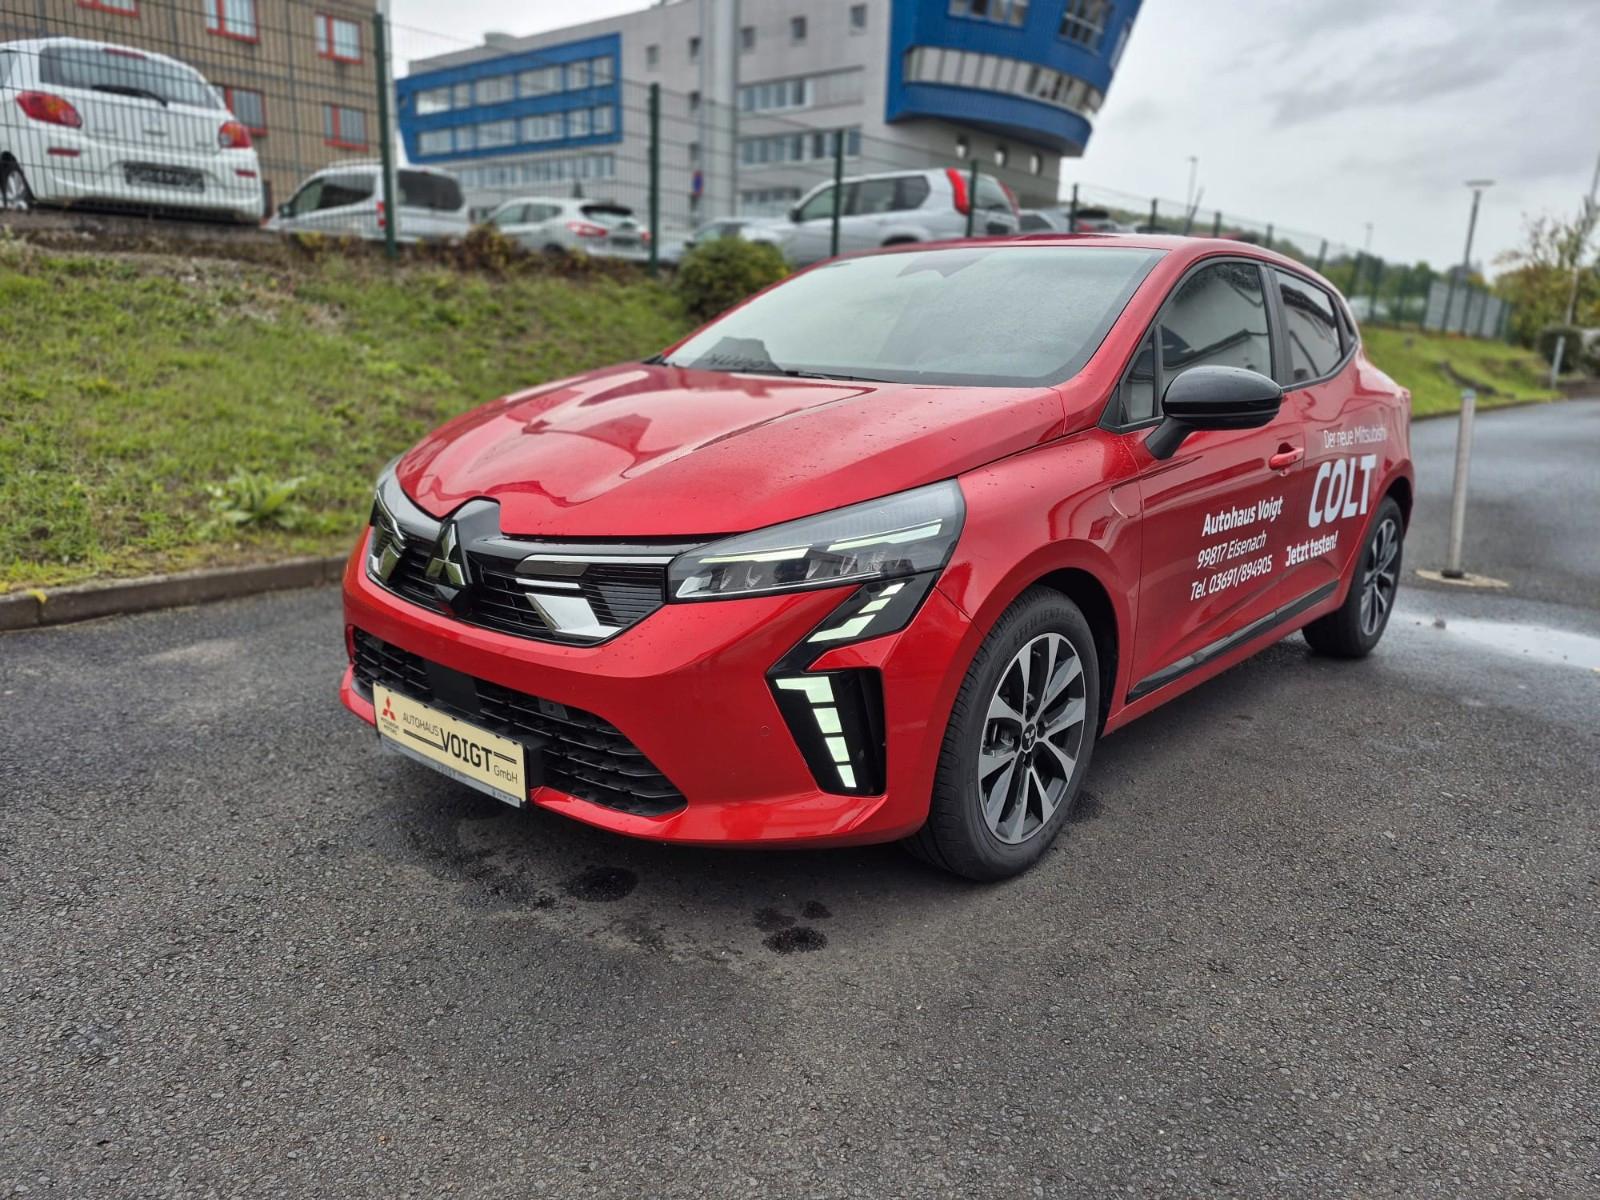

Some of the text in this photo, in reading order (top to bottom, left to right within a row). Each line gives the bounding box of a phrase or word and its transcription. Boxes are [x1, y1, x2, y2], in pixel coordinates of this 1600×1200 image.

[1323, 429, 1338, 449] Der
[1338, 429, 1355, 447] neue
[1307, 454, 1377, 528] COLT
[1202, 495, 1284, 537] Autohaus Voigt
[1196, 531, 1267, 570] 99817 Eisenach
[1285, 531, 1339, 567] Jetzt testen!
[1190, 554, 1273, 601] Tel. 03691/894905
[402, 712, 440, 737] AUTOHAUS
[440, 727, 493, 772] VOIGT
[493, 764, 518, 784] GmbH
